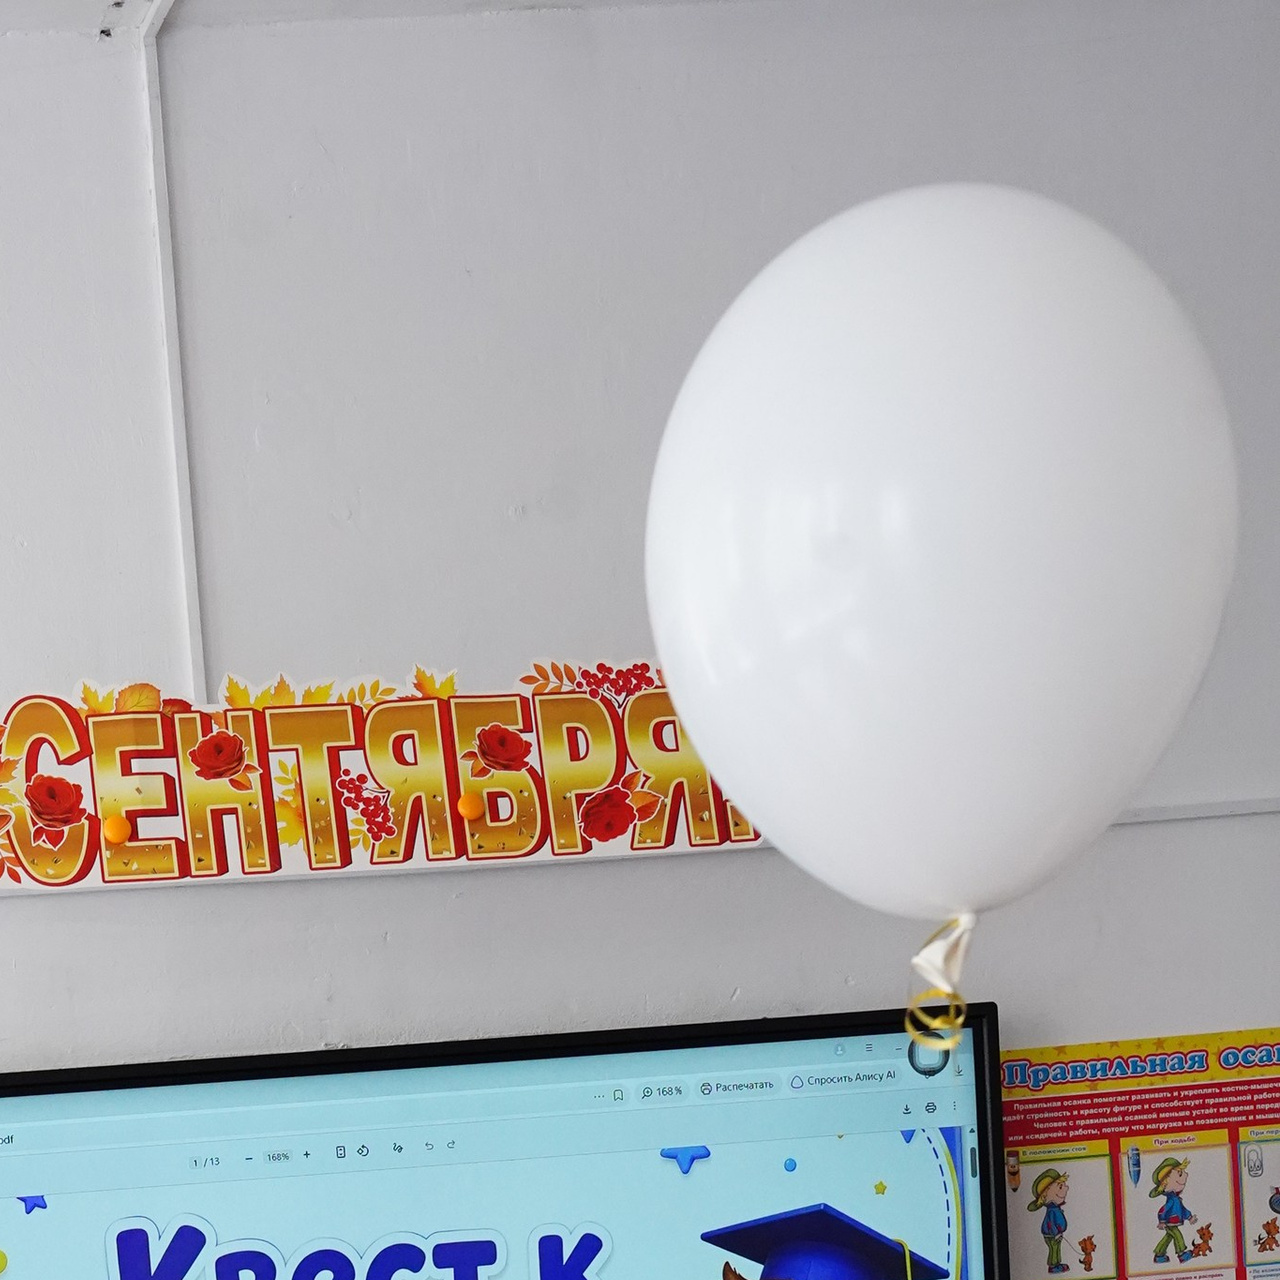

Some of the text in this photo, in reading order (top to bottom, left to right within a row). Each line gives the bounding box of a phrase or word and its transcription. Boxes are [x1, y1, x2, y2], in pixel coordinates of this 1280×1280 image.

[1003, 1050, 1207, 1089] Правильная
[716, 1080, 774, 1093] Распечатать
[807, 1073, 853, 1087] Спросить
[855, 1072, 884, 1083] Алису
[267, 1152, 290, 1162] 168%
